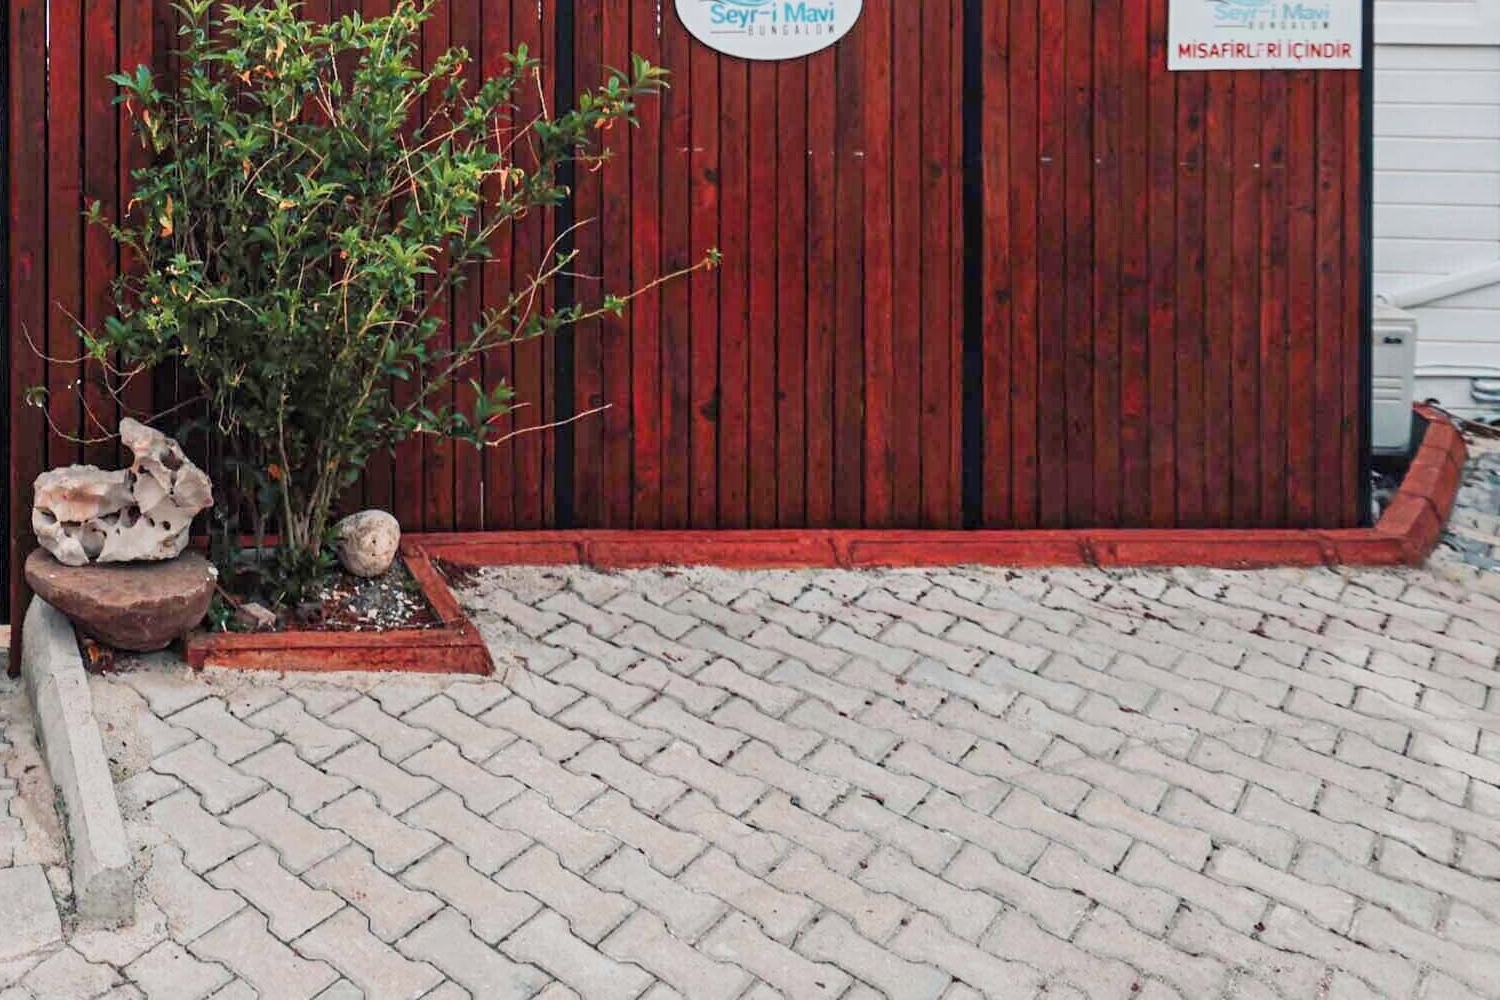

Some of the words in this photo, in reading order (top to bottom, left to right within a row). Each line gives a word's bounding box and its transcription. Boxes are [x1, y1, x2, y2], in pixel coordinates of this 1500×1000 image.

[710, 3, 777, 28] Seyr-i
[784, 2, 835, 23] Mavi
[1214, 3, 1277, 23] Seyr-i
[1283, 3, 1330, 20] Mavi
[748, 24, 835, 36] BUNGALOW
